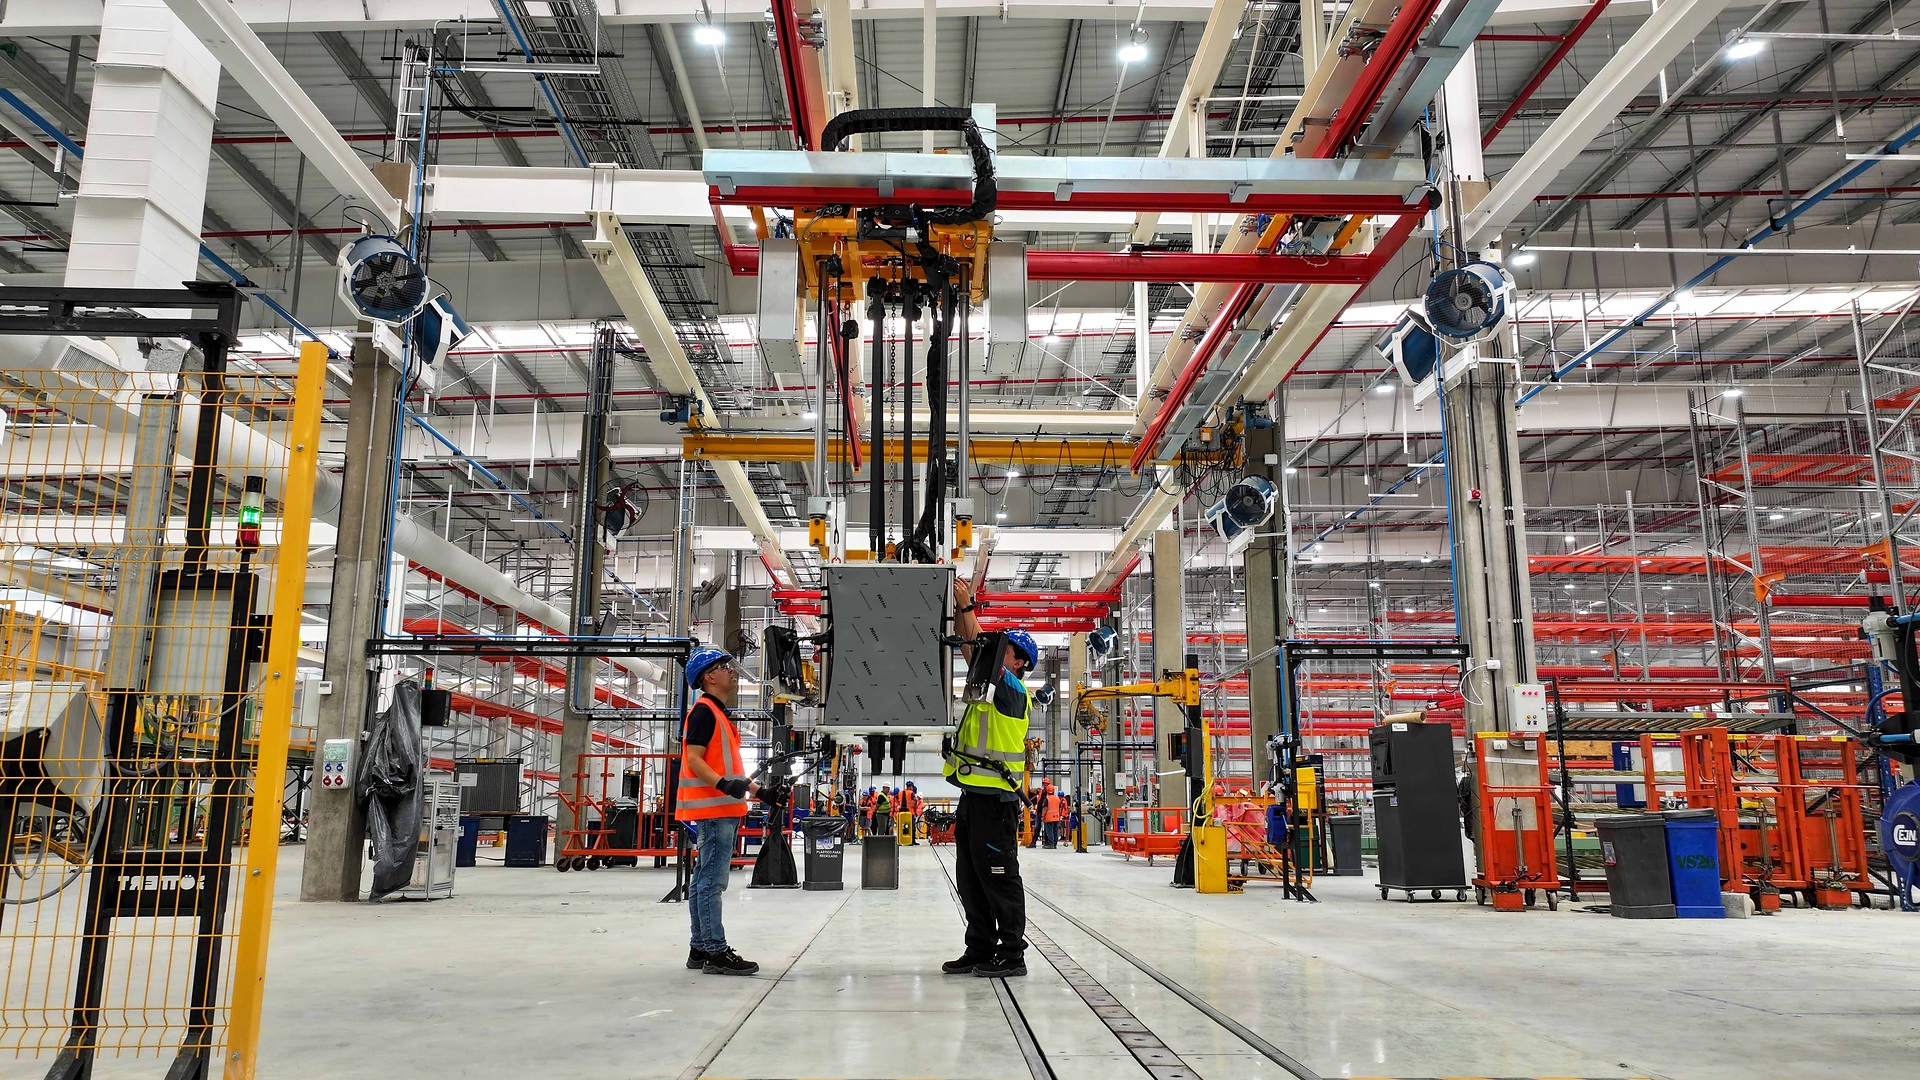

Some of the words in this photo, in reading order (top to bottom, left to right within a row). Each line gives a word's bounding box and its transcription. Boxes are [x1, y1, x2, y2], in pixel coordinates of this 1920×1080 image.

[877, 593, 887, 609] Nitto
[869, 627, 880, 642] Nitto
[862, 660, 872, 676] Nitto
[922, 660, 933, 676] Nitto
[854, 694, 865, 710] Nitto
[915, 694, 926, 710] Nitto
[1893, 824, 1917, 846] CEJN
